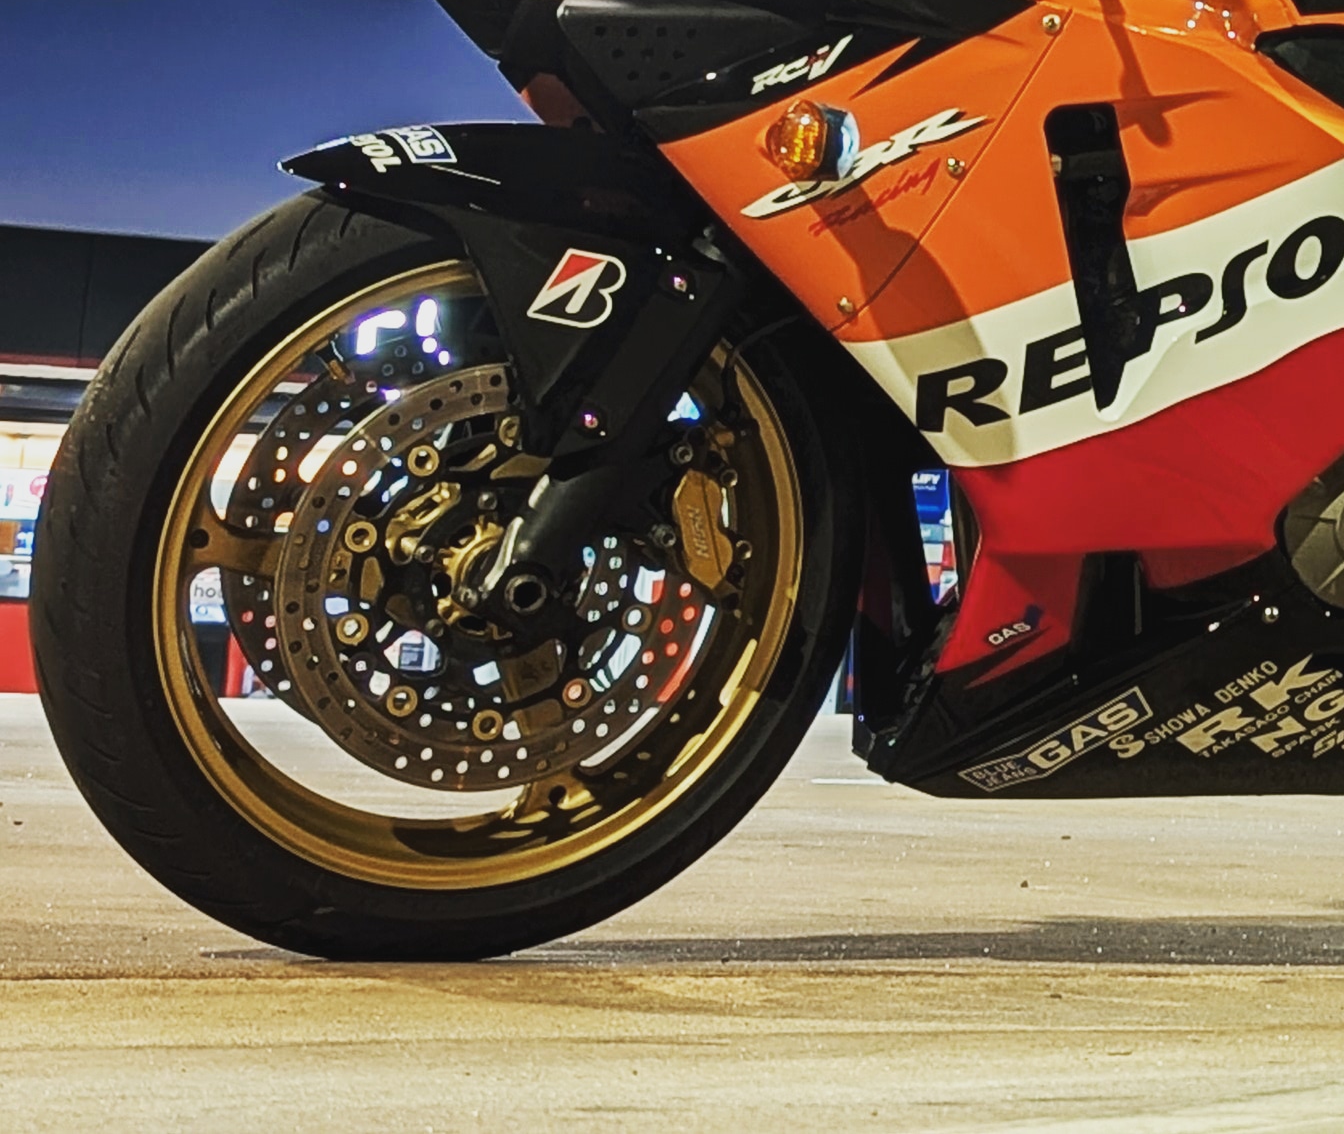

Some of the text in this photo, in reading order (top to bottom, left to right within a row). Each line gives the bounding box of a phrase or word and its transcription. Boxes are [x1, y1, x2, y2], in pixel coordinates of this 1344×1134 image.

[1144, 702, 1211, 744] SHOWA
[1214, 660, 1278, 703] DENKO
[1176, 652, 1334, 753] RK
[1294, 669, 1343, 704] CHAIN
[1027, 702, 1139, 769] GAS
